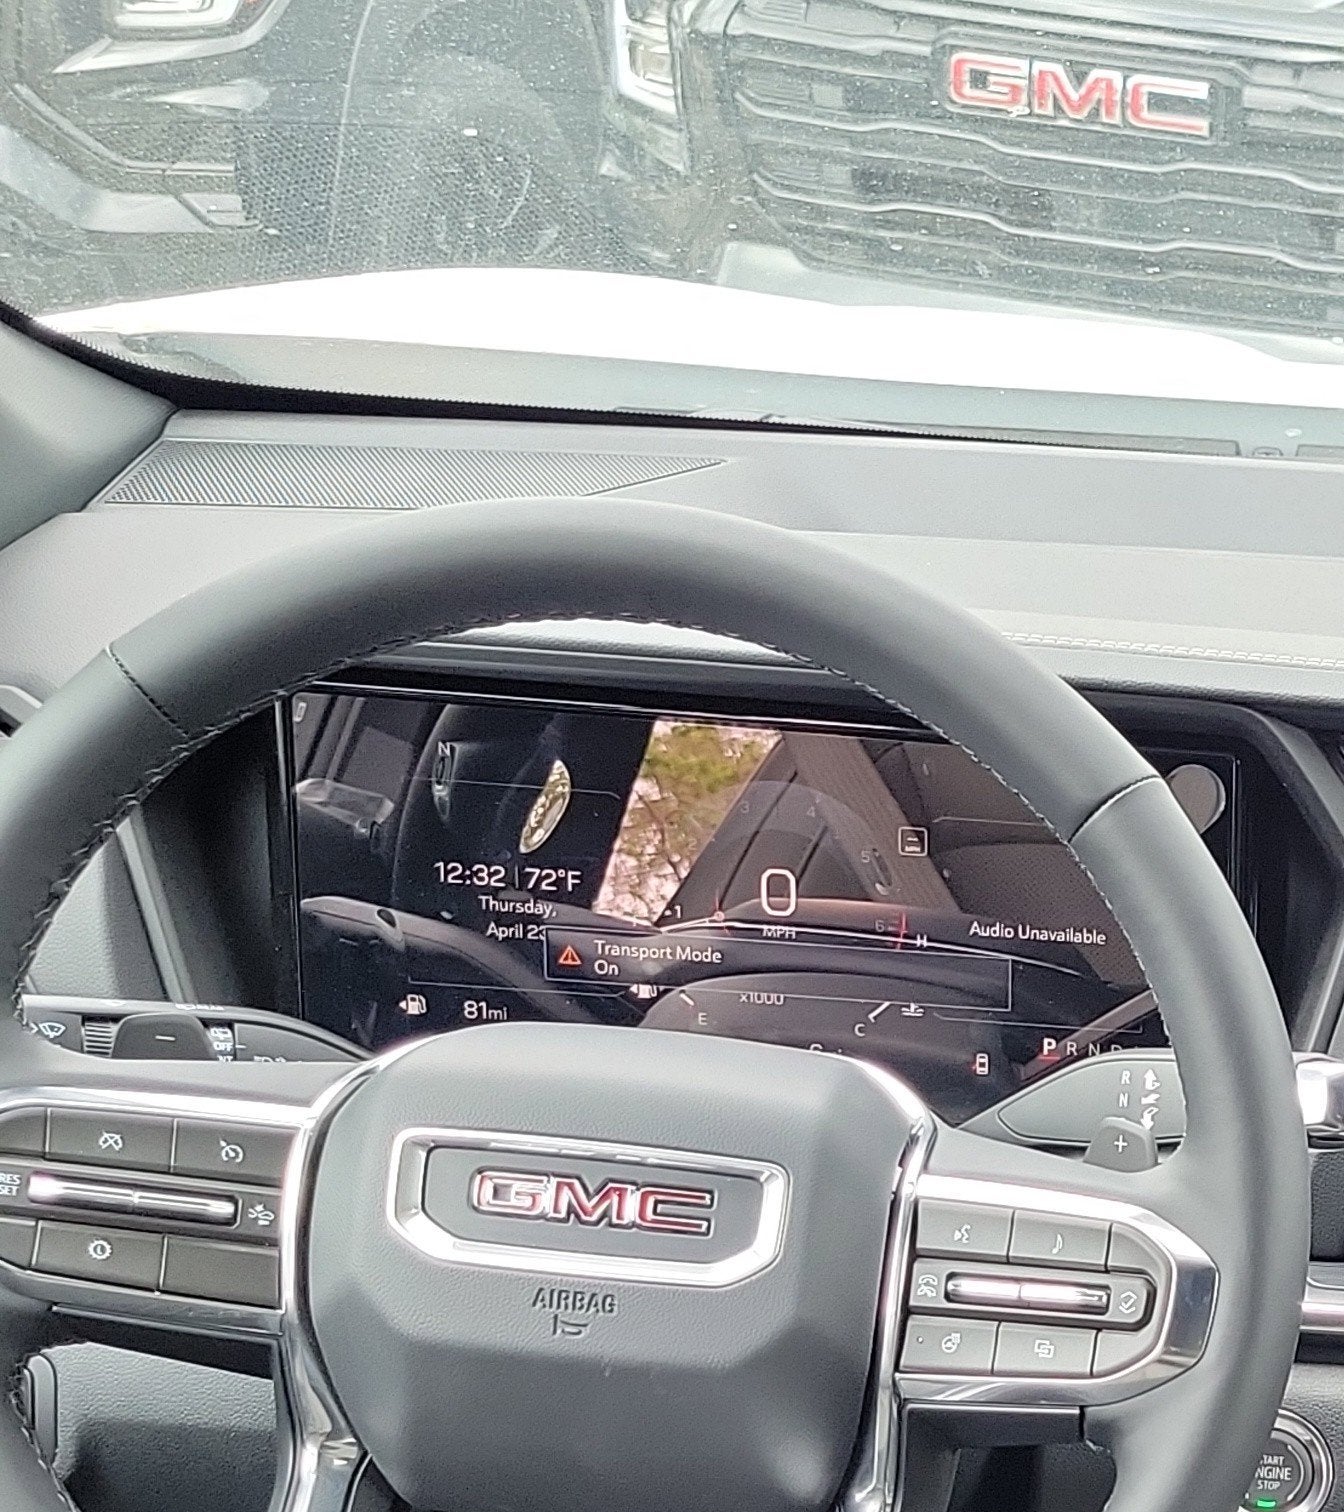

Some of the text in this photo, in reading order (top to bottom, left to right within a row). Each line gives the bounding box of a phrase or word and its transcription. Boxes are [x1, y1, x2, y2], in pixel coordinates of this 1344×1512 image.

[947, 48, 1211, 139] GMC
[437, 741, 451, 755] N
[433, 861, 582, 893] 12:32 72°F
[761, 868, 797, 917] 0
[478, 895, 557, 919] Thursday,
[673, 905, 682, 919] 1
[486, 921, 524, 941] April
[762, 925, 797, 940] MPH
[969, 921, 1107, 945] Audio Unavailable
[594, 939, 723, 964] Transport Mode
[594, 959, 619, 976] On
[698, 1012, 707, 1025] E
[854, 1023, 866, 1037] C
[213, 1041, 234, 1052] OFF
[1043, 1038, 1100, 1056] P R N
[1120, 1070, 1130, 1084] R
[1119, 1093, 1129, 1108] N
[473, 1168, 716, 1237] GMC
[531, 1287, 617, 1314] AIRBAG
[1260, 1454, 1285, 1466] TART
[1255, 1466, 1292, 1481] NGINE
[1257, 1481, 1281, 1490] STOP
